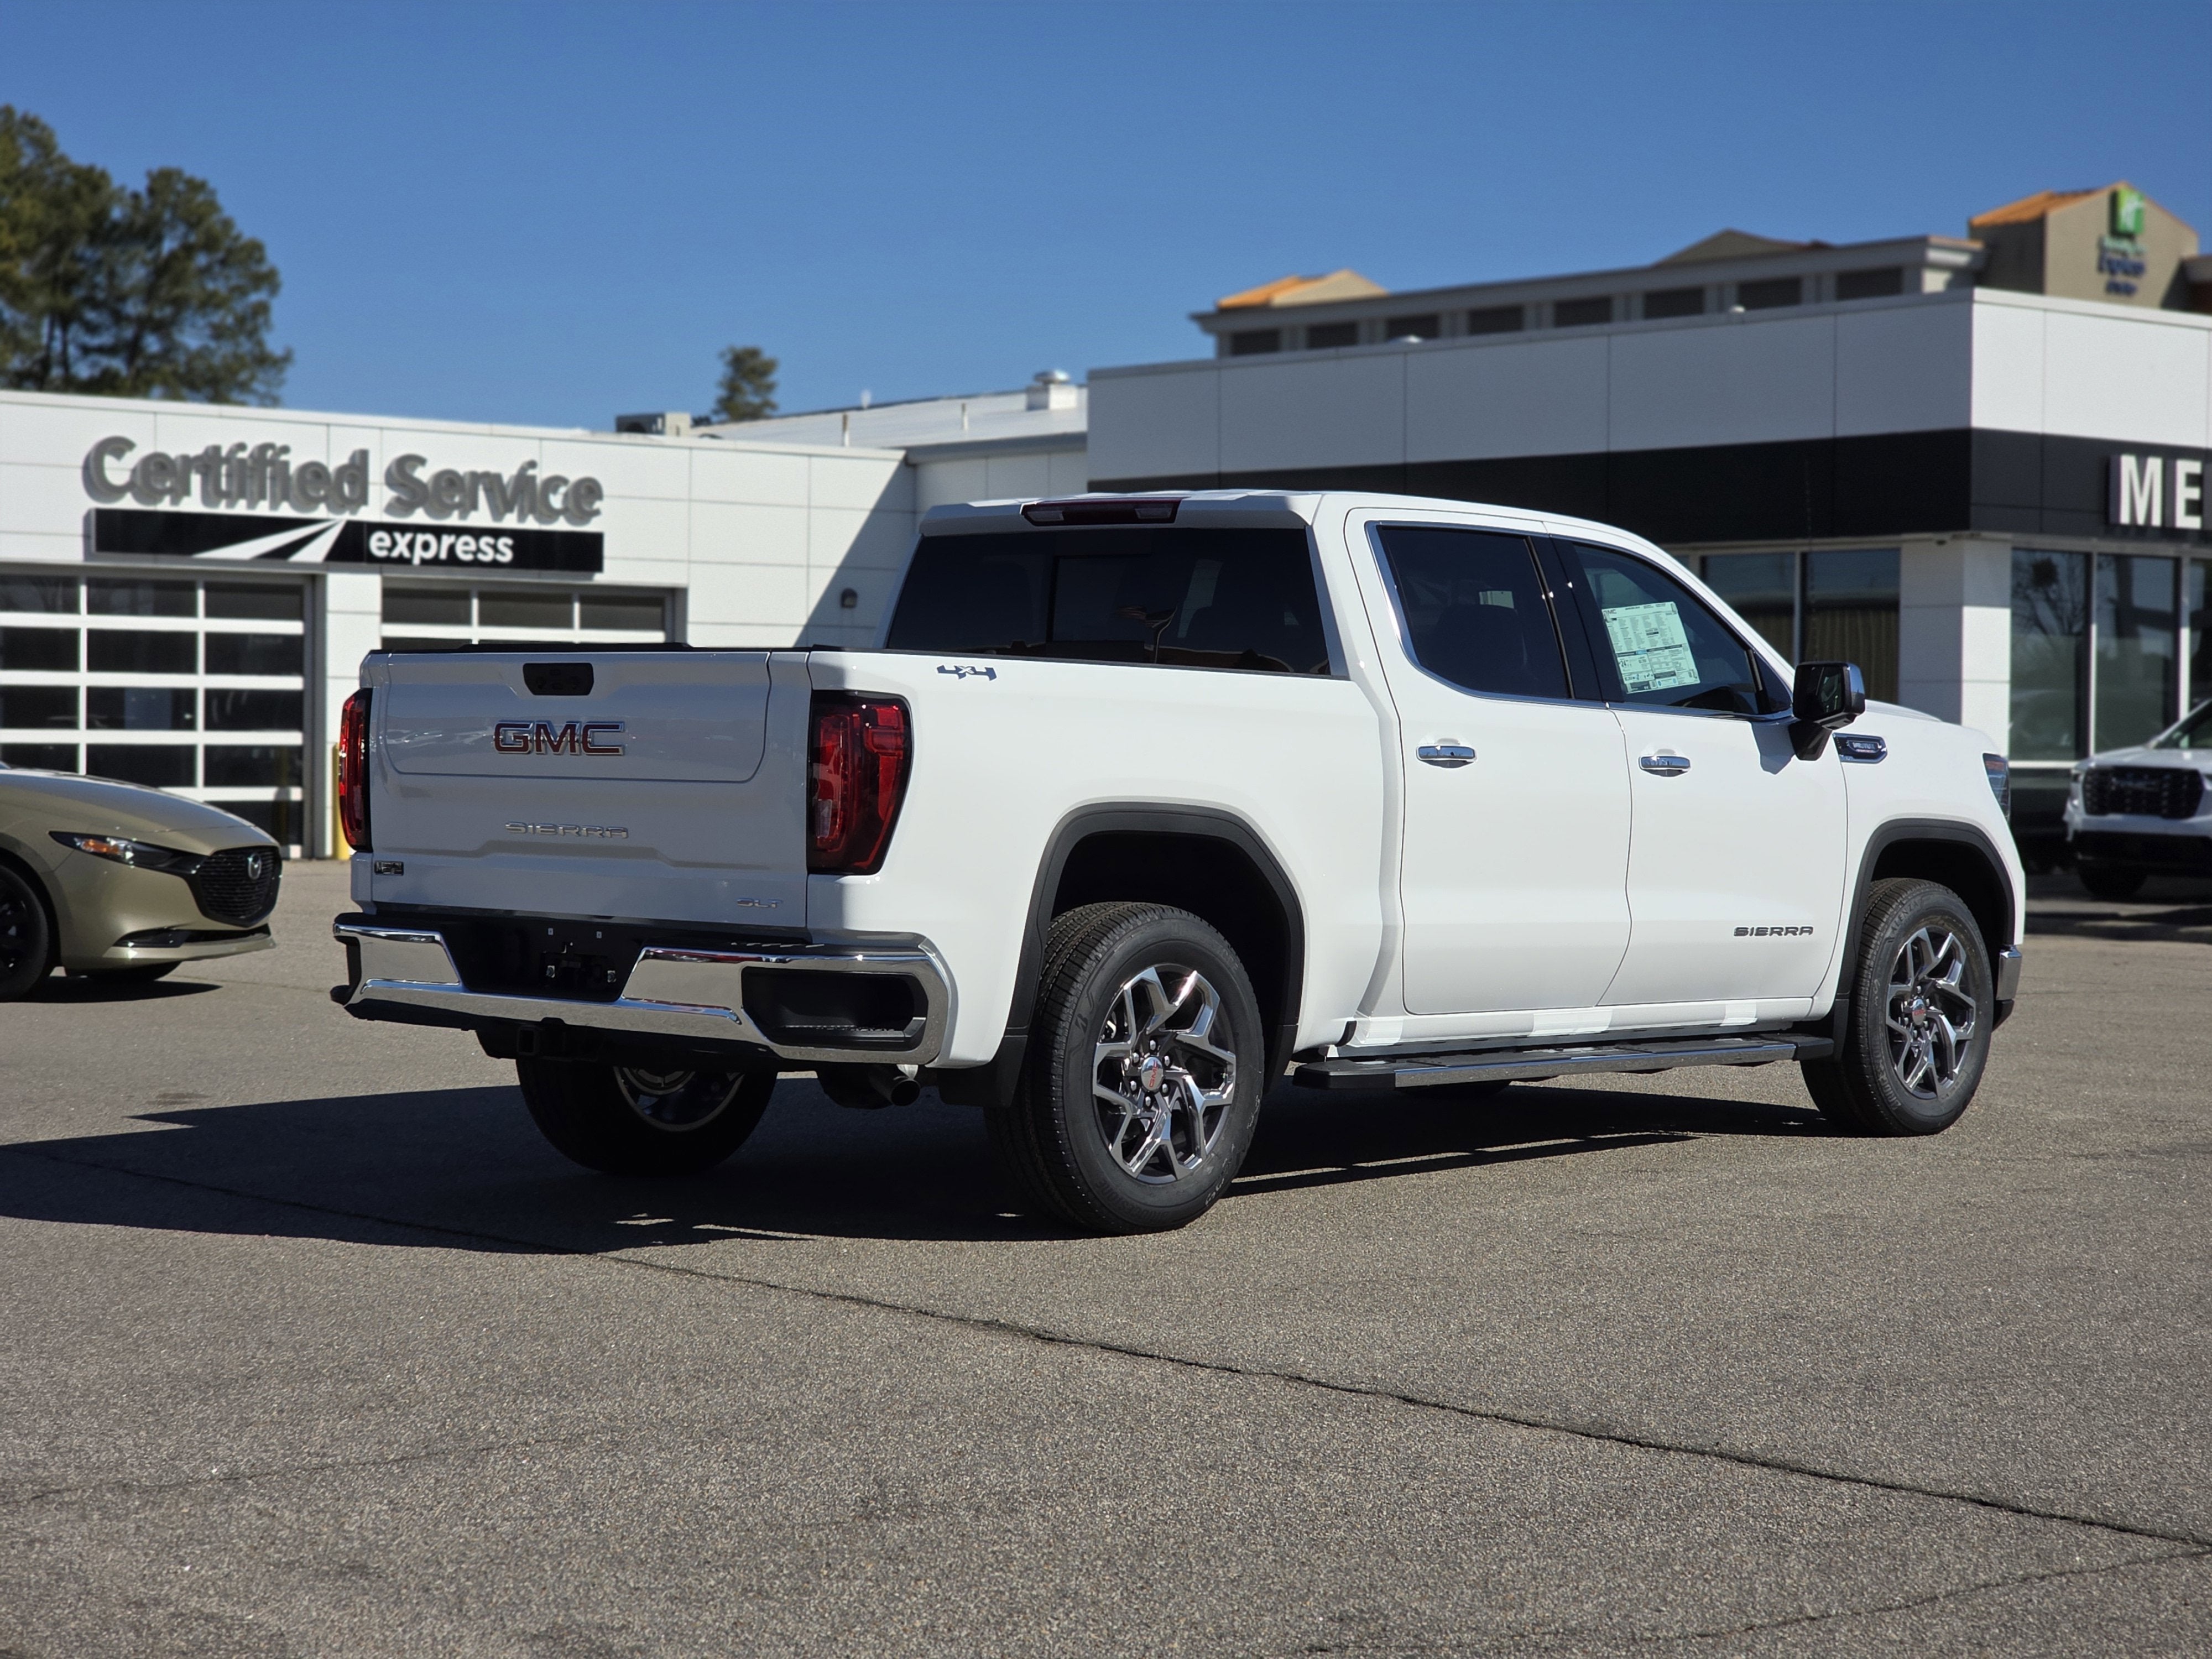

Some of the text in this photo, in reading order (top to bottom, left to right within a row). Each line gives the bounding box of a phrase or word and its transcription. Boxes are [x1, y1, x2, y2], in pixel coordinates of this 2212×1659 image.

[83, 436, 604, 526] Certified Service
[2120, 454, 2202, 530] ME
[369, 530, 514, 565] express
[494, 719, 625, 756] GMC
[505, 822, 629, 839] SIERRA
[1734, 926, 1813, 937] SIERRA
